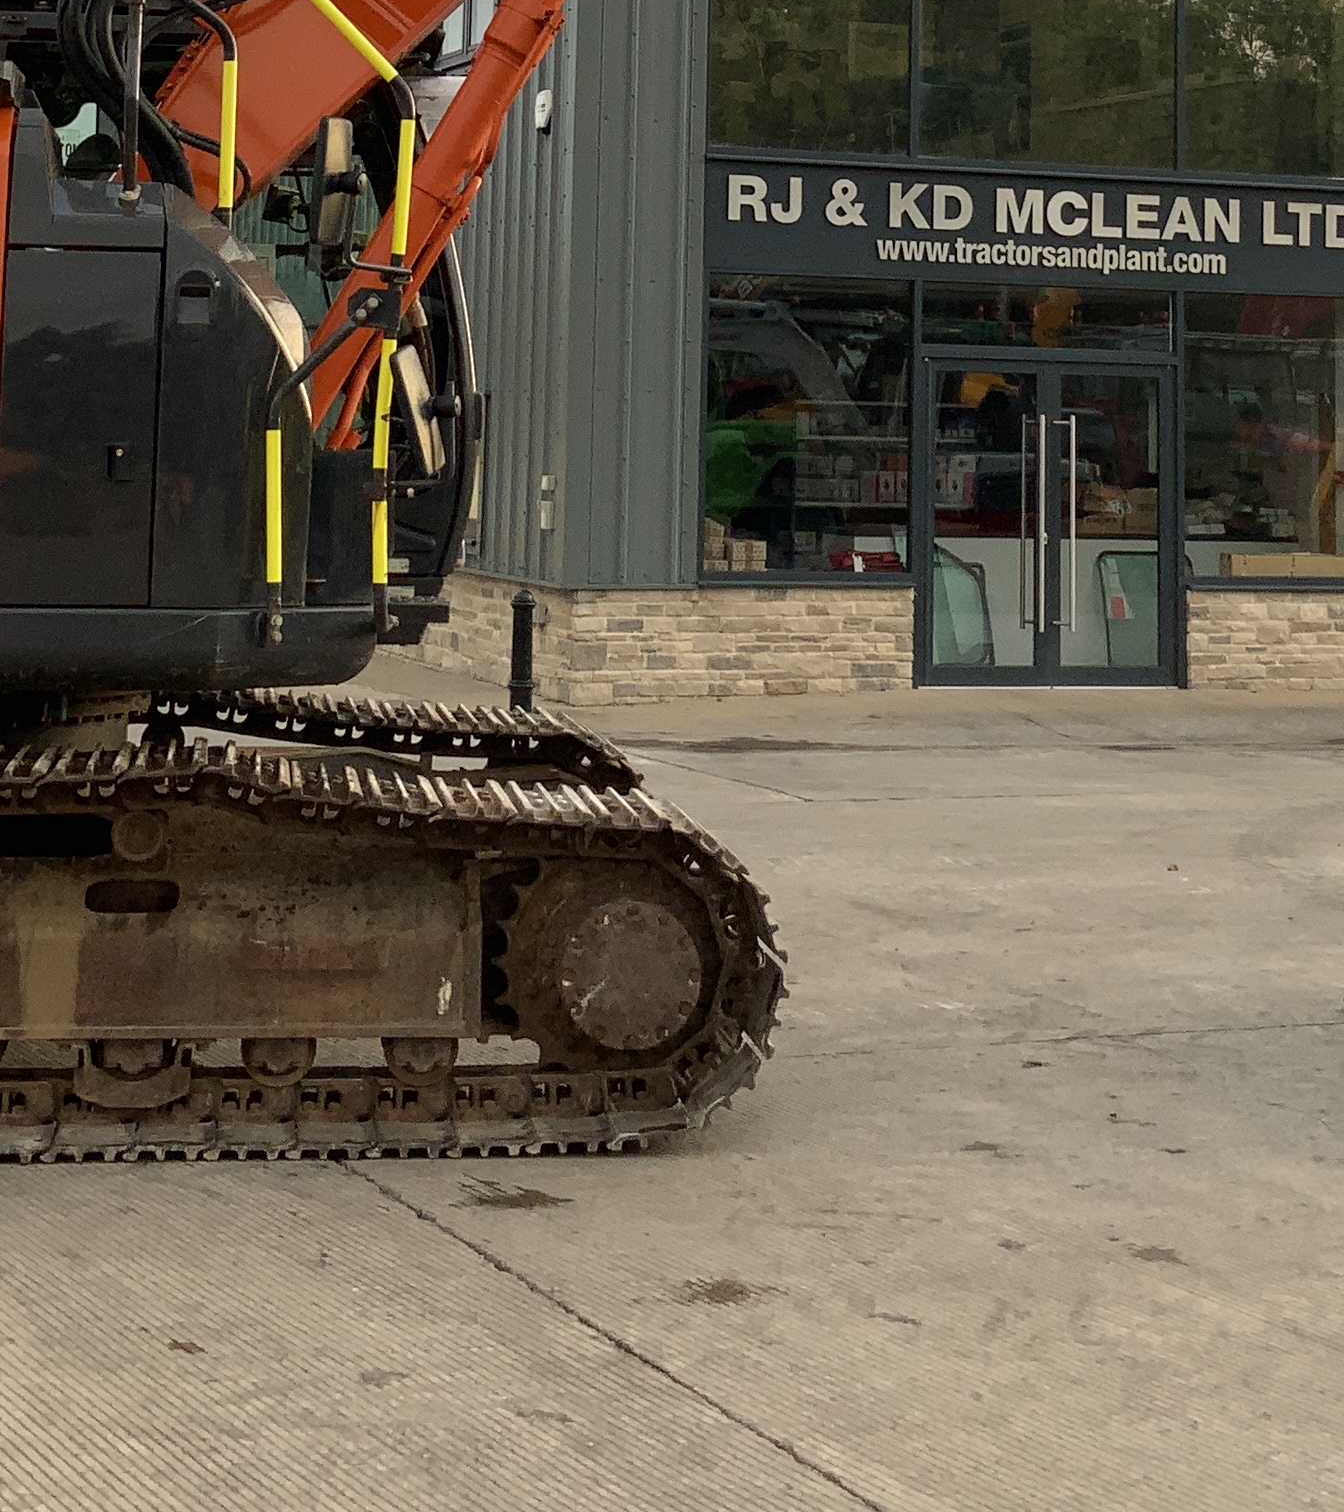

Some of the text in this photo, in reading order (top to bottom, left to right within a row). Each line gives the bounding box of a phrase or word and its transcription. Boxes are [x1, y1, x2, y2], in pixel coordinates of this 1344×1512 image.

[727, 174, 803, 224] RJ
[825, 178, 868, 227] &
[889, 182, 973, 231] KD
[995, 186, 1241, 243] MCLEAN
[876, 237, 1227, 275] www.tractorsandplant.com
